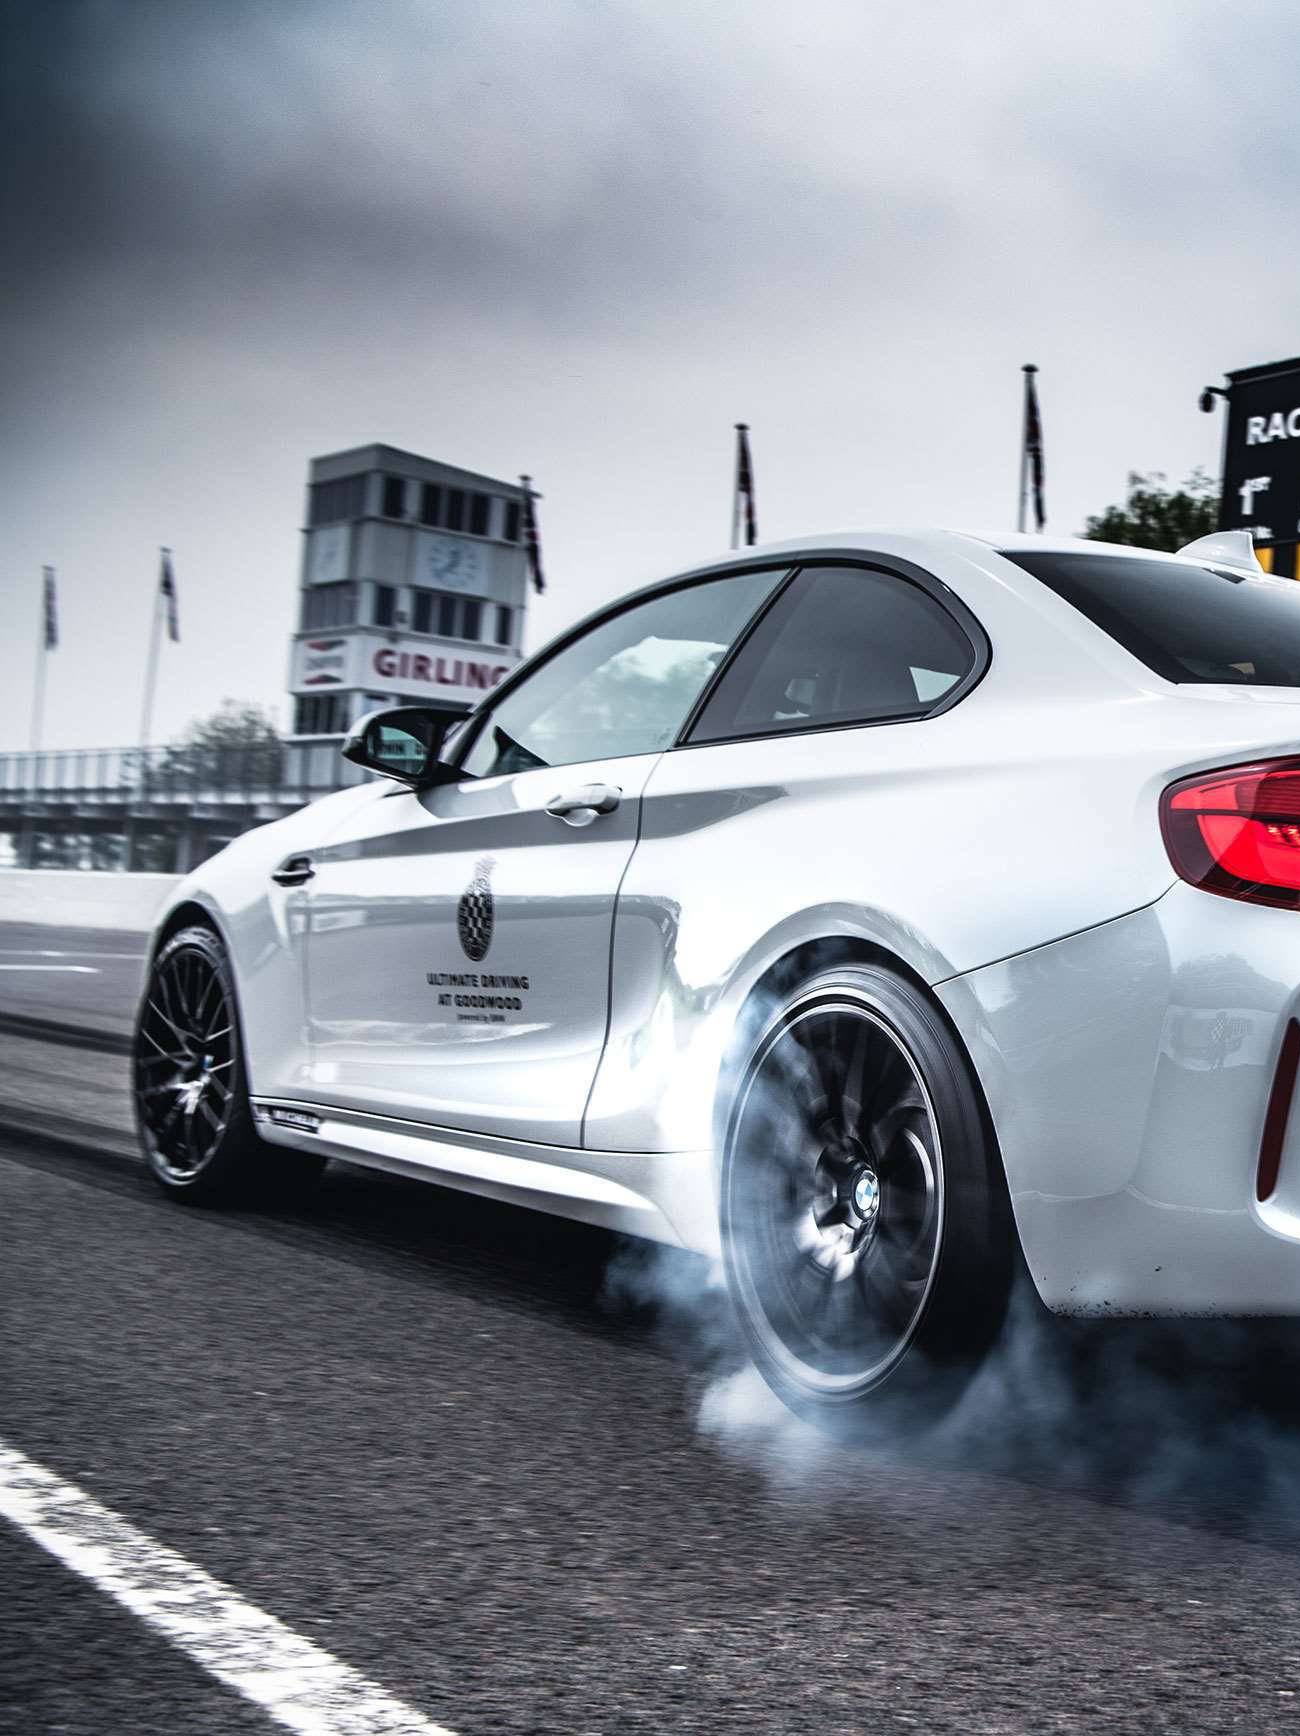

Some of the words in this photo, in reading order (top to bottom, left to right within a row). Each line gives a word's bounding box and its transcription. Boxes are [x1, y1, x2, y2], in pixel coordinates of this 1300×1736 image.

[426, 972, 479, 988] ULTIMATE
[481, 974, 530, 990] DRIVING
[438, 993, 452, 1006] AT
[454, 994, 522, 1010] GOODWOOD
